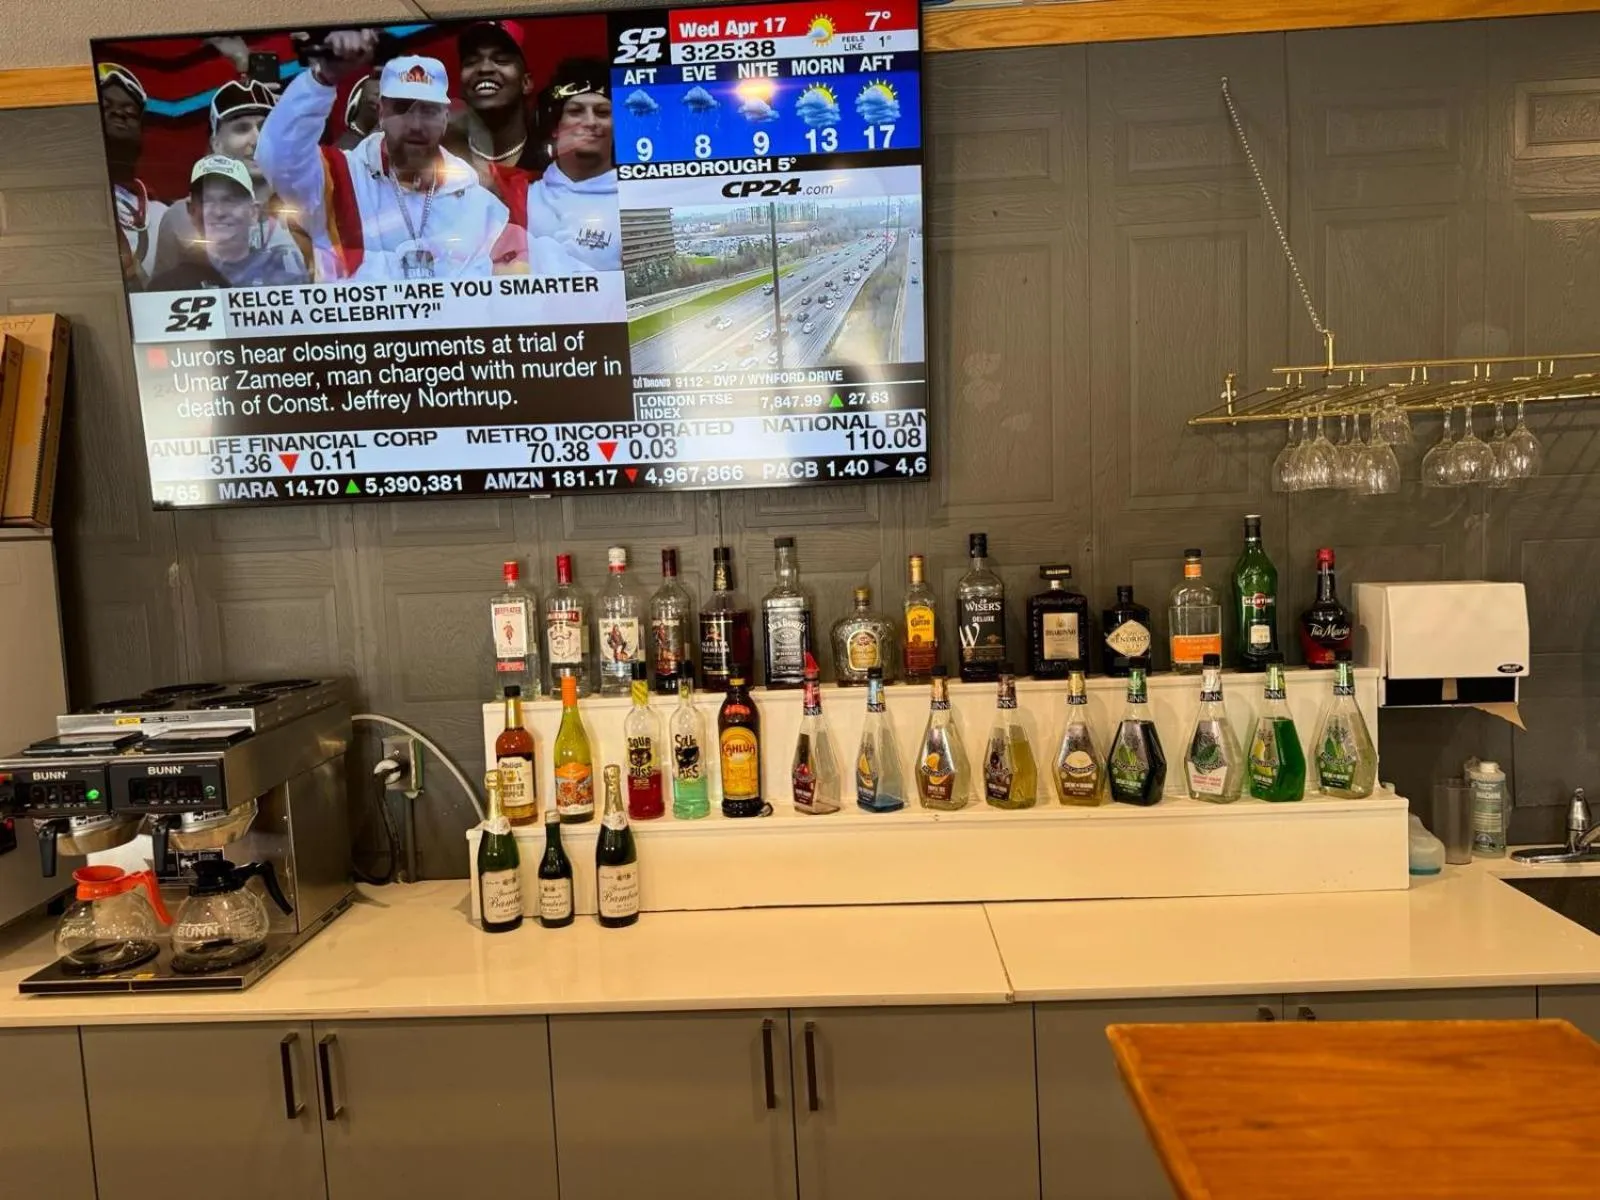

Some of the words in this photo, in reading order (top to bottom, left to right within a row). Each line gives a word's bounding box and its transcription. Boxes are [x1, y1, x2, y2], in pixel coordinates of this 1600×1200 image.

[619, 27, 666, 45] CP
[679, 22, 719, 38] Wed
[725, 19, 758, 37] Apr
[763, 17, 787, 33] 17
[842, 34, 865, 43] FEELS
[613, 45, 663, 64] 24
[681, 39, 776, 62] 3:25:38
[843, 42, 864, 52] LIKE
[623, 67, 657, 85] AFT
[682, 64, 717, 82] EVE
[738, 61, 779, 78] NITE
[791, 57, 844, 76] MORN
[859, 54, 894, 73] AFT
[636, 137, 653, 162] 9
[694, 134, 712, 159] 8
[752, 131, 770, 156] 9
[805, 127, 838, 153] 13
[863, 124, 896, 150] 17
[619, 157, 772, 180] SCARBOROUGH
[228, 288, 295, 308] KELCE
[300, 288, 327, 306] TO
[334, 285, 387, 304] HOST
[395, 282, 444, 300] "ARE
[450, 280, 493, 297] YOU
[500, 276, 600, 295] SMARTER
[170, 296, 216, 314] CP
[230, 309, 284, 328] THAN
[290, 308, 304, 325] A
[310, 302, 442, 323] CELEBRITY?"
[164, 314, 213, 333] 24
[171, 347, 236, 369] Jurors
[241, 344, 287, 365] hear
[293, 340, 367, 364] closing
[373, 335, 486, 363] arguments
[492, 336, 512, 354] at
[518, 331, 557, 353] trial
[563, 330, 585, 351] of
[173, 372, 230, 394] Umar
[235, 368, 321, 391] Zameer,
[327, 367, 373, 387] man
[378, 361, 465, 387] charged
[471, 360, 515, 381] with
[521, 357, 597, 379] murder
[603, 356, 622, 376] in
[675, 376, 704, 389] 9112
[714, 375, 739, 387] DVP
[747, 372, 805, 386] WYNFORD
[808, 370, 844, 382] DRIVE
[176, 397, 235, 419] death
[241, 395, 262, 415] of
[267, 394, 335, 414] Const.
[341, 390, 412, 414] Jeffrey
[418, 388, 519, 410] Northrup.
[639, 394, 696, 408] LONDON
[700, 392, 734, 406] FTSE
[848, 392, 889, 406] 27.63
[640, 407, 681, 421] INDEX
[151, 437, 242, 458] ANULIFE
[249, 432, 367, 453] FINANCIAL
[373, 430, 438, 448] CORP
[466, 427, 548, 445] METRO
[555, 419, 735, 442] INCORPORATED
[761, 414, 878, 434] NATIONAL
[211, 454, 272, 476] 31.36
[310, 450, 357, 471] 0.11
[527, 442, 590, 464] 70.38
[629, 439, 678, 460] 0.03
[845, 428, 922, 451] 110.08
[219, 480, 279, 501] MARA
[284, 479, 340, 497] 14.70
[365, 474, 463, 496] 5,390,381
[484, 471, 544, 490] AMZN
[551, 469, 618, 488] 181.17
[644, 464, 744, 488] 4,967,866
[762, 462, 819, 480] PACB
[826, 460, 869, 478] 1.40
[964, 600, 1002, 612] WISER'S
[177, 923, 221, 938] BUNN
